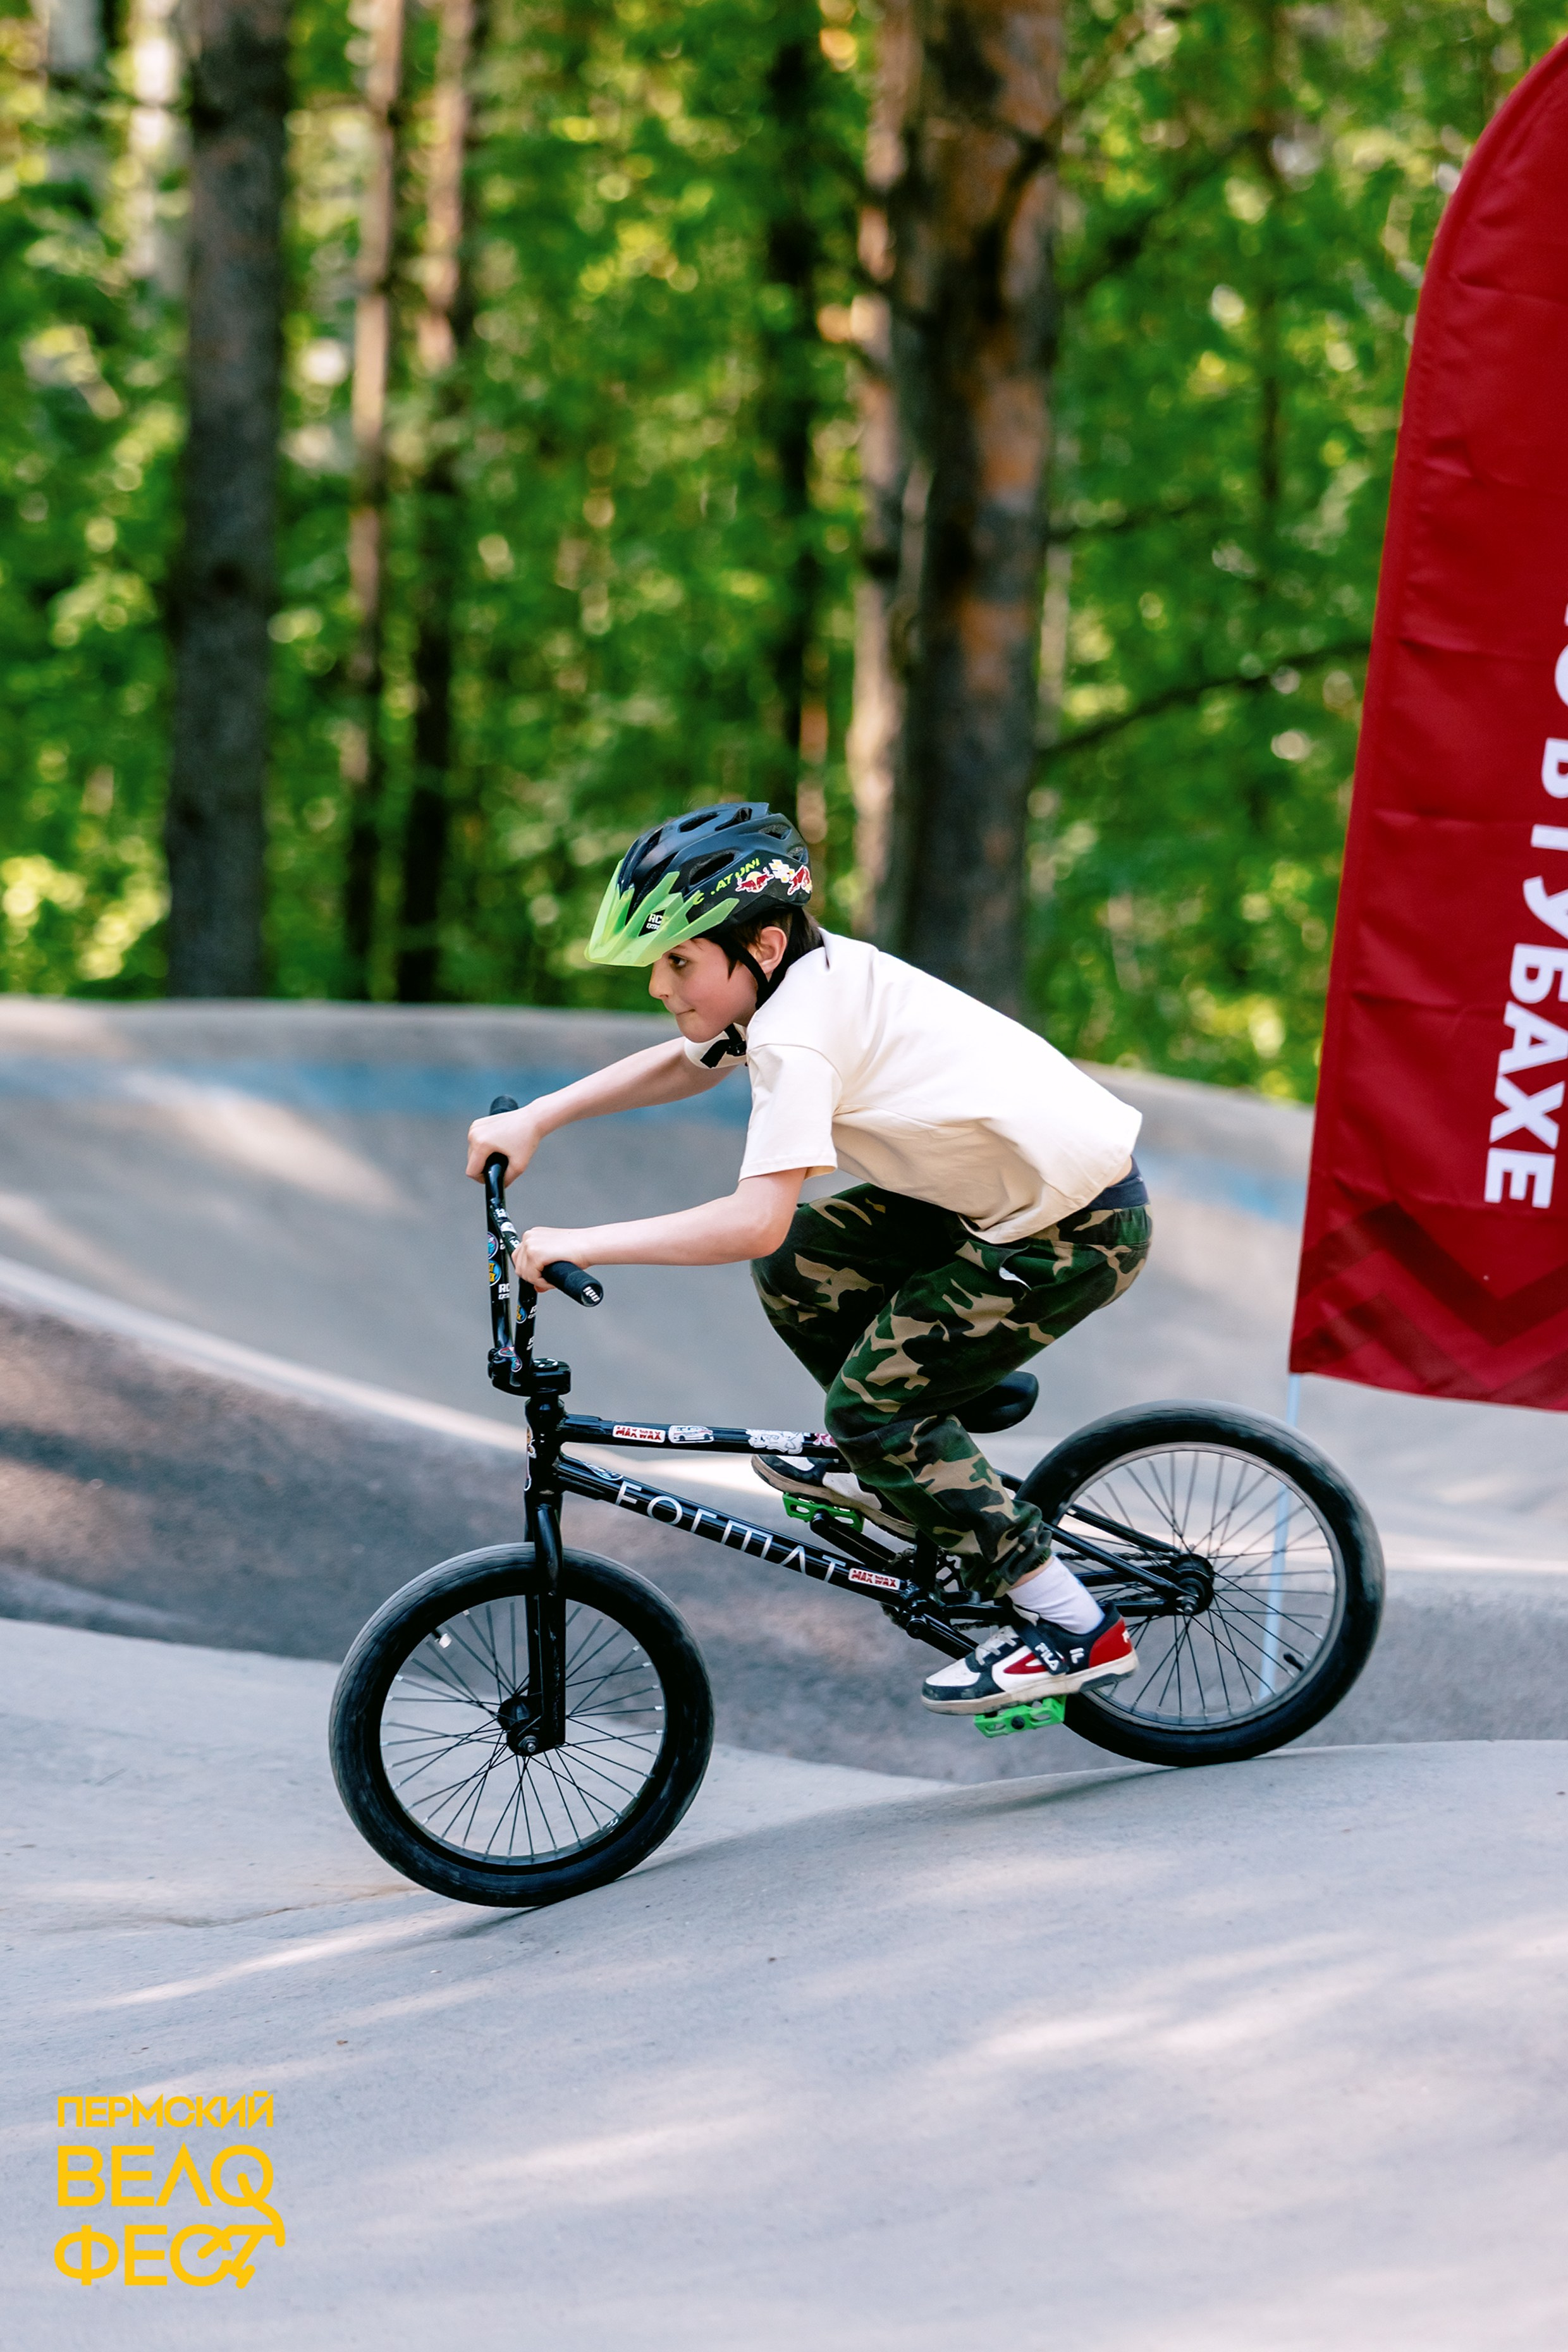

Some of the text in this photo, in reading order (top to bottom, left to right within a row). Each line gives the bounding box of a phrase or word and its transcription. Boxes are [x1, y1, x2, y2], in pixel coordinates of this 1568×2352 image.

[615, 1426, 662, 1441] MAX WAX
[851, 1569, 897, 1588] MAX WAX
[1034, 1642, 1060, 1671] FILA
